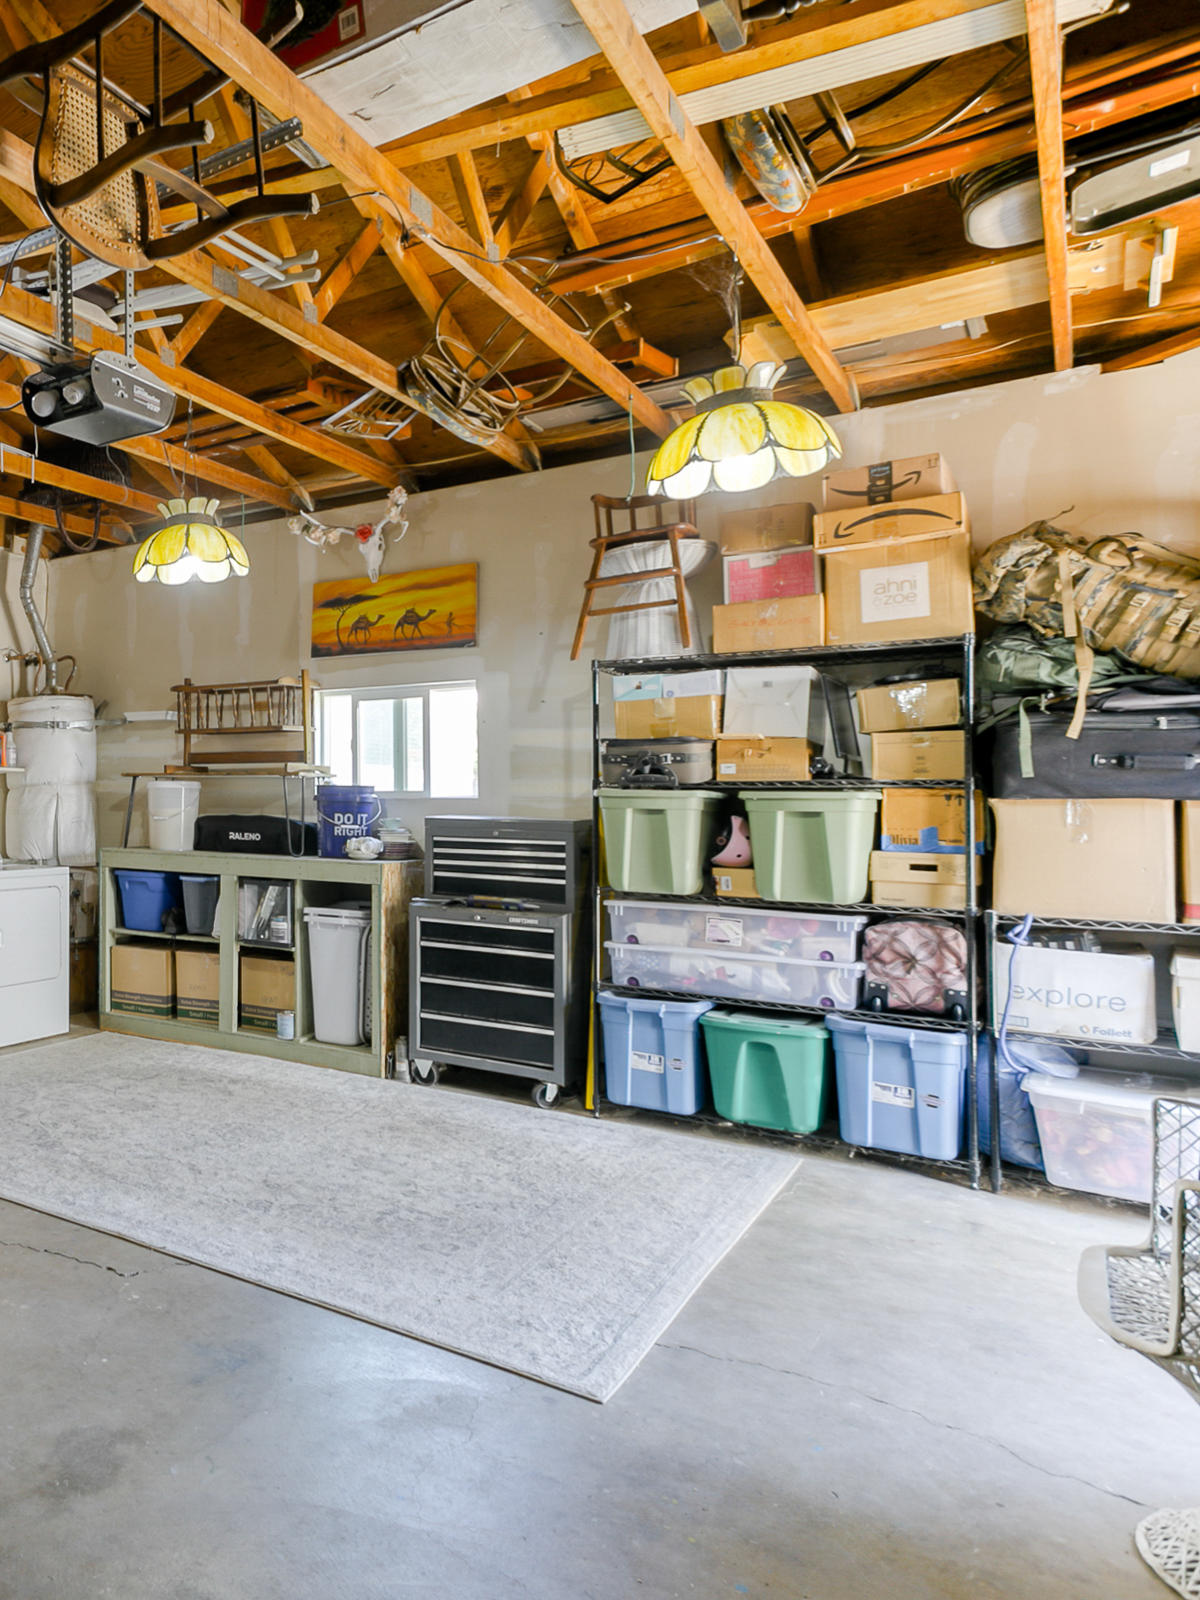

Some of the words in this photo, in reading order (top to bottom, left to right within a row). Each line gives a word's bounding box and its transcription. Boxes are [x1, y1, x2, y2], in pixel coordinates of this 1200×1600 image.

[873, 575, 917, 595] ahni
[334, 812, 353, 825] DO
[357, 813, 368, 825] IT
[228, 831, 261, 841] RALENO
[334, 825, 368, 836] RIGHT
[1012, 984, 1127, 1013] explore
